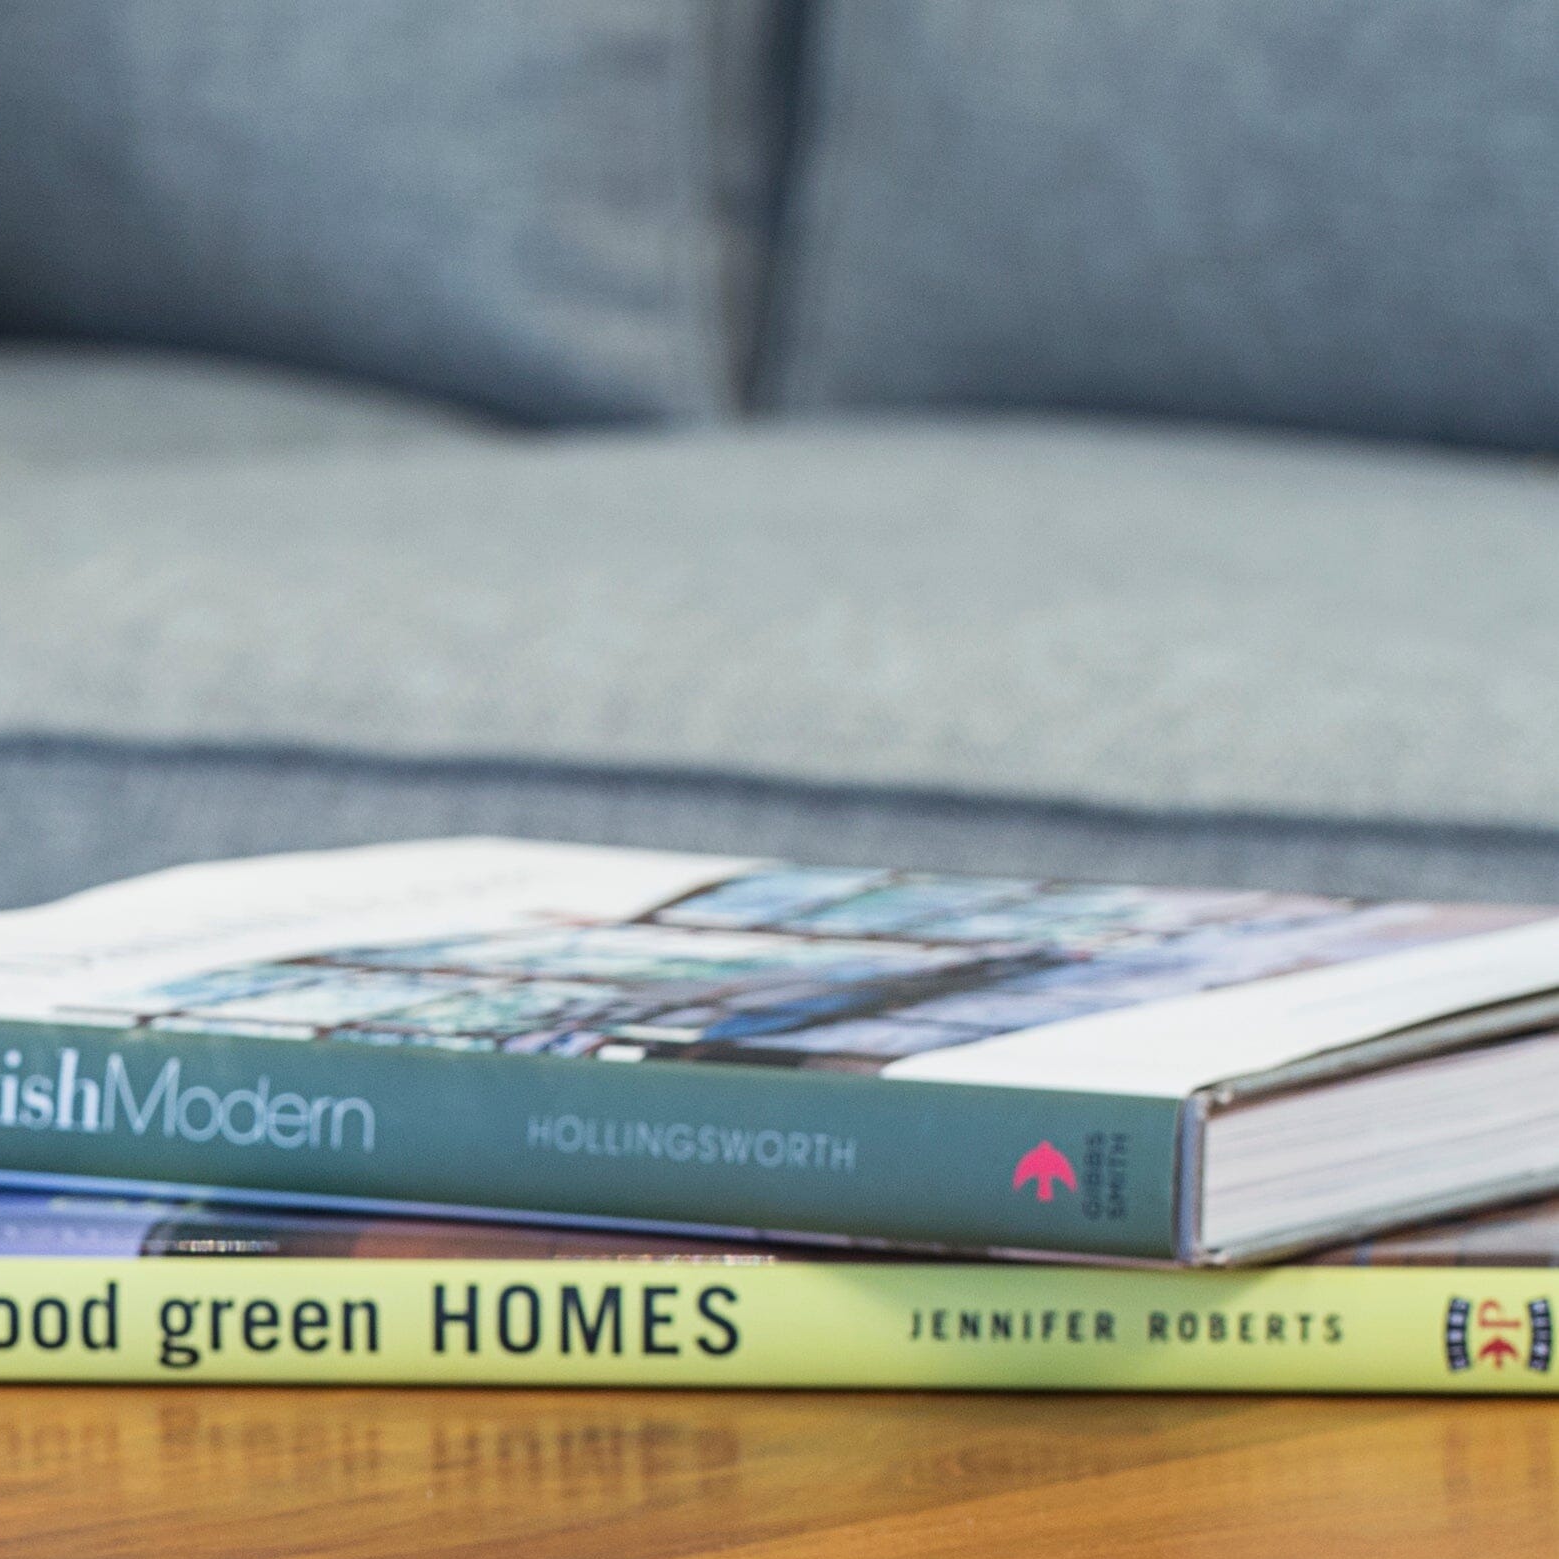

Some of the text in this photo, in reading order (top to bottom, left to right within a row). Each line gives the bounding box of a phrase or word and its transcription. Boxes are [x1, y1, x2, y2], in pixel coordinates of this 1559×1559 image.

[526, 1113, 857, 1174] HOLLINGSWORTH
[158, 1297, 380, 1367] green
[430, 1283, 741, 1357] HOMES
[909, 1309, 1344, 1343] JENNIFER ROBERTS
